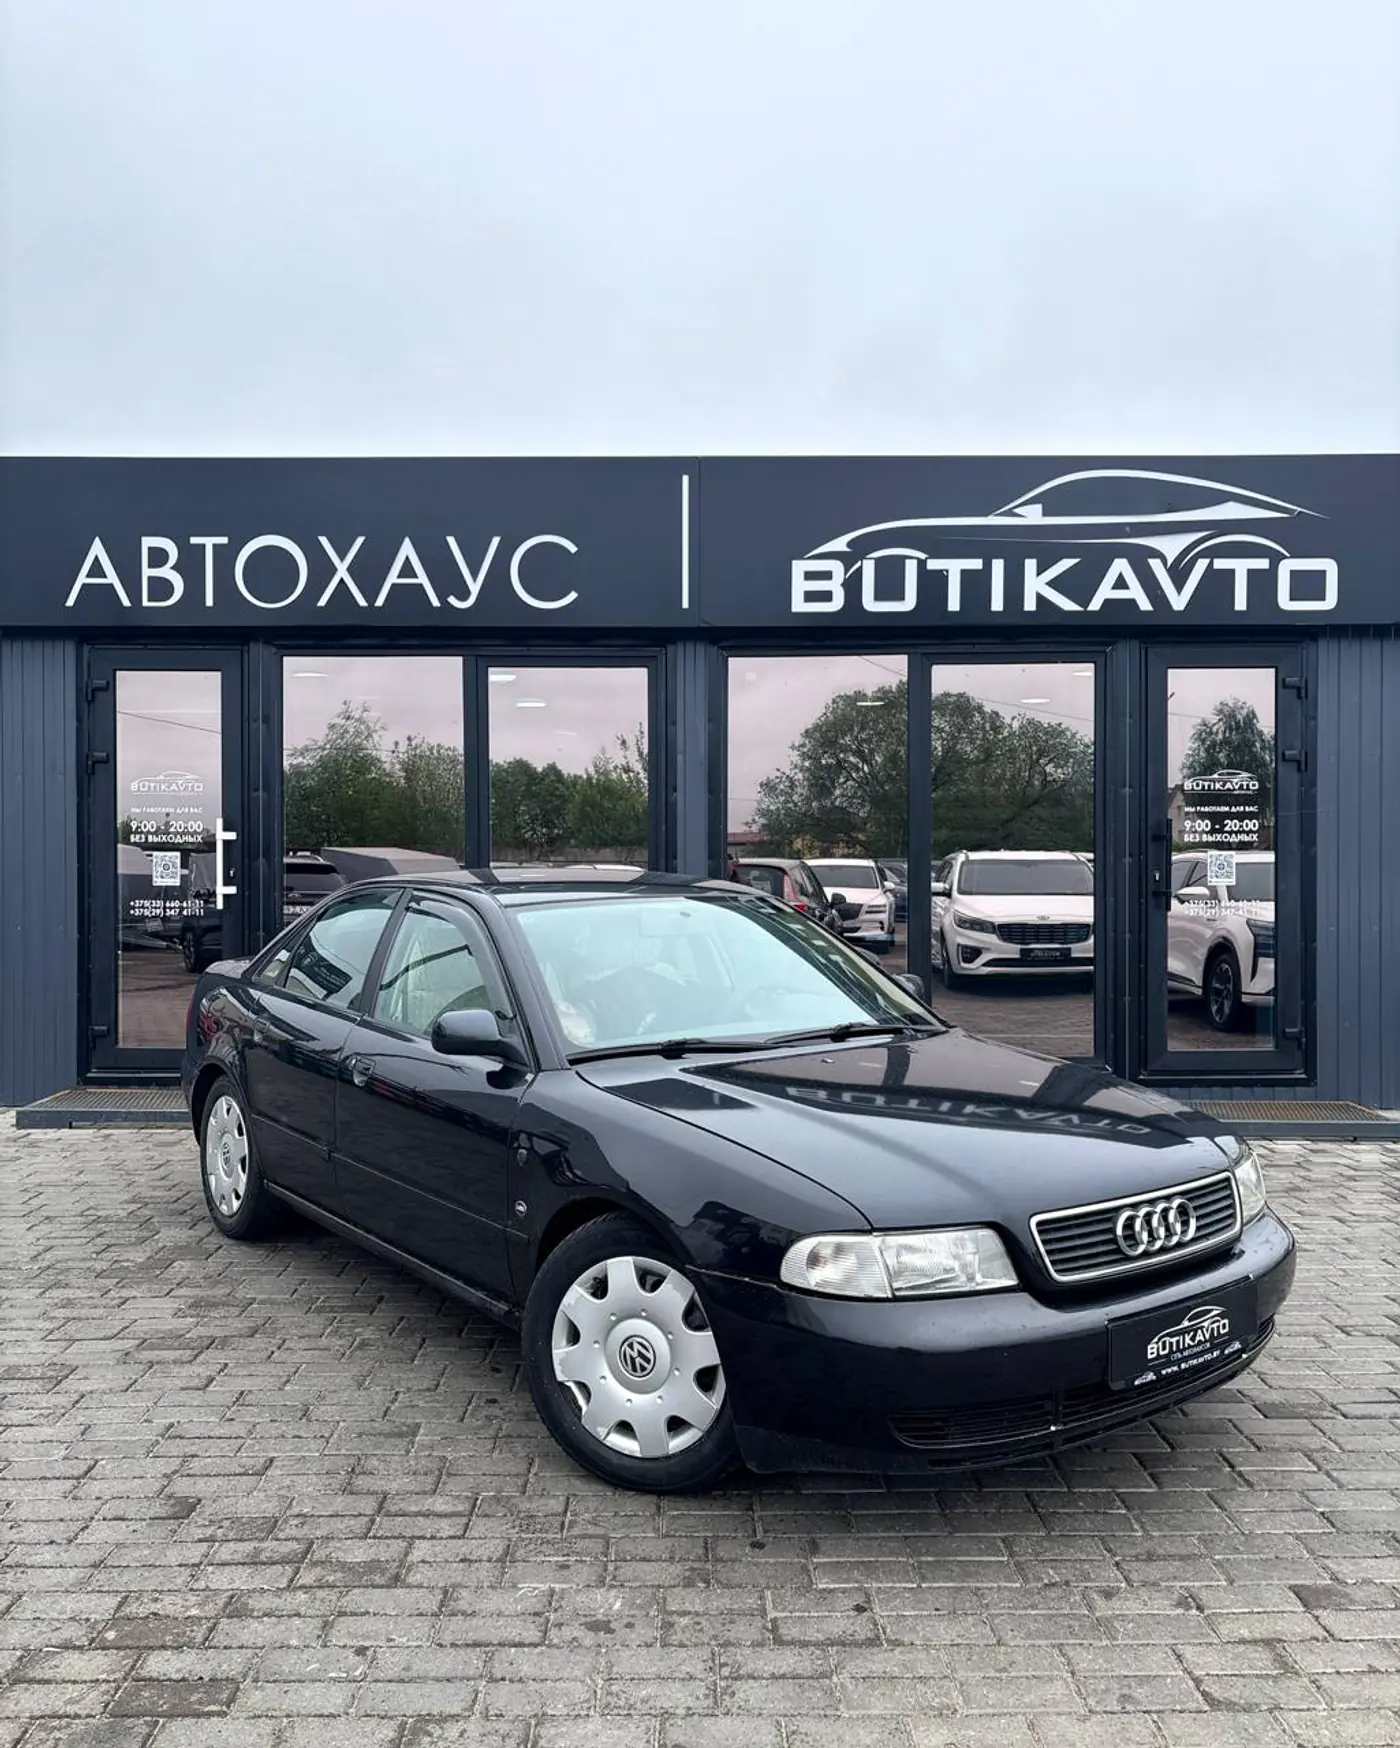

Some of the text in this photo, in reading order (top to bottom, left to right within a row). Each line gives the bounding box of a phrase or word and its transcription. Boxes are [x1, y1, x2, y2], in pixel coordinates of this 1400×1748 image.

[65, 534, 579, 609] АВТОХАУС
[790, 557, 1339, 613] BUTIKAVTO
[131, 782, 204, 792] BUTIKAVTO
[1184, 781, 1259, 791] BUTIKAVTO
[130, 821, 157, 832] 9:00
[169, 821, 203, 832] 20:00
[1184, 820, 1211, 831] 9:00
[1223, 820, 1259, 831] 20:00
[130, 835, 203, 844] БЕЗ ВЫХОДНЫХ
[1184, 834, 1258, 842] БЕЗ ВЫХОДНЫХ
[165, 908, 204, 916] 34741-11
[1147, 1319, 1229, 1359] BUTIKAVTO
